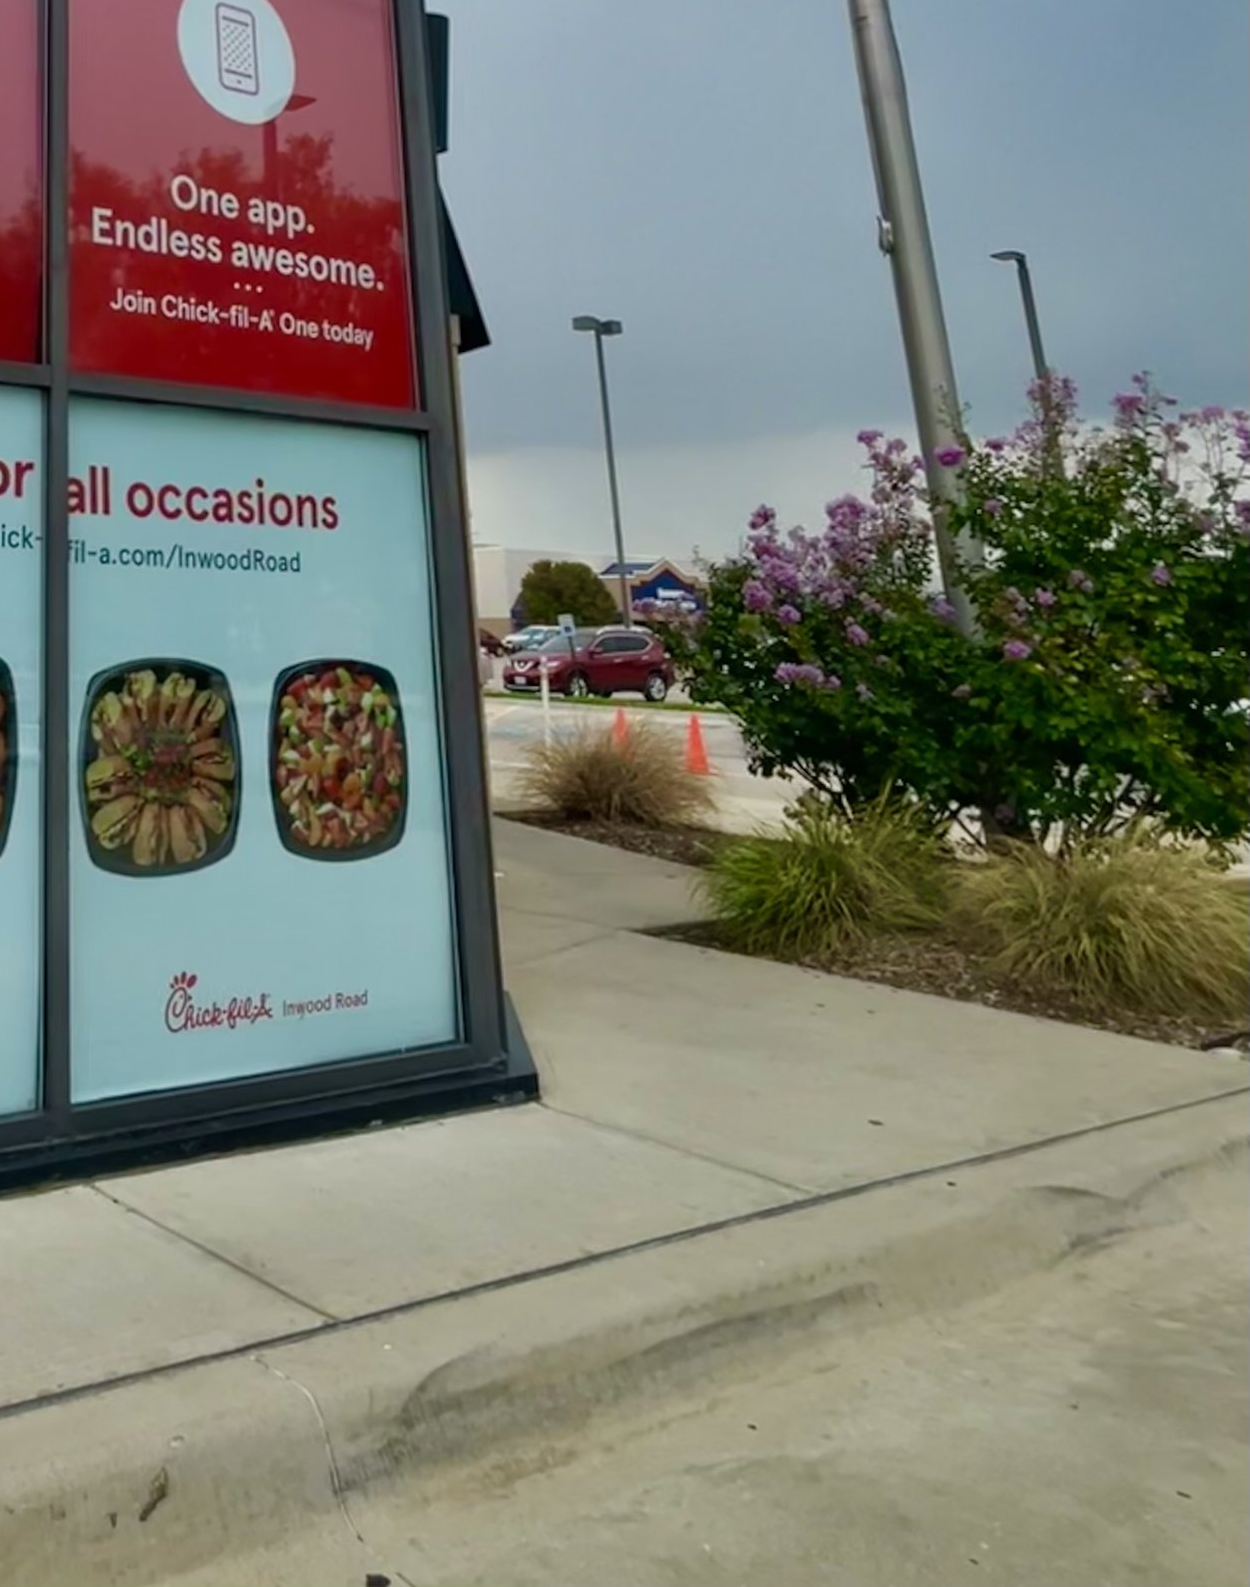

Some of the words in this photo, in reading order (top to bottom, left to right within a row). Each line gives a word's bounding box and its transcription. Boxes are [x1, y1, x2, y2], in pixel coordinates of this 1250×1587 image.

[170, 175, 239, 218] One
[248, 196, 315, 239] app.
[92, 207, 223, 262] Endless
[231, 242, 385, 291] awesome.
[110, 288, 156, 315] Join
[279, 313, 319, 339] One
[323, 320, 374, 351] today
[67, 465, 112, 516] all
[126, 478, 339, 529] occasions
[165, 971, 274, 1033] Chick-fil-A
[282, 994, 332, 1020] Inwood
[335, 989, 369, 1010] Road
